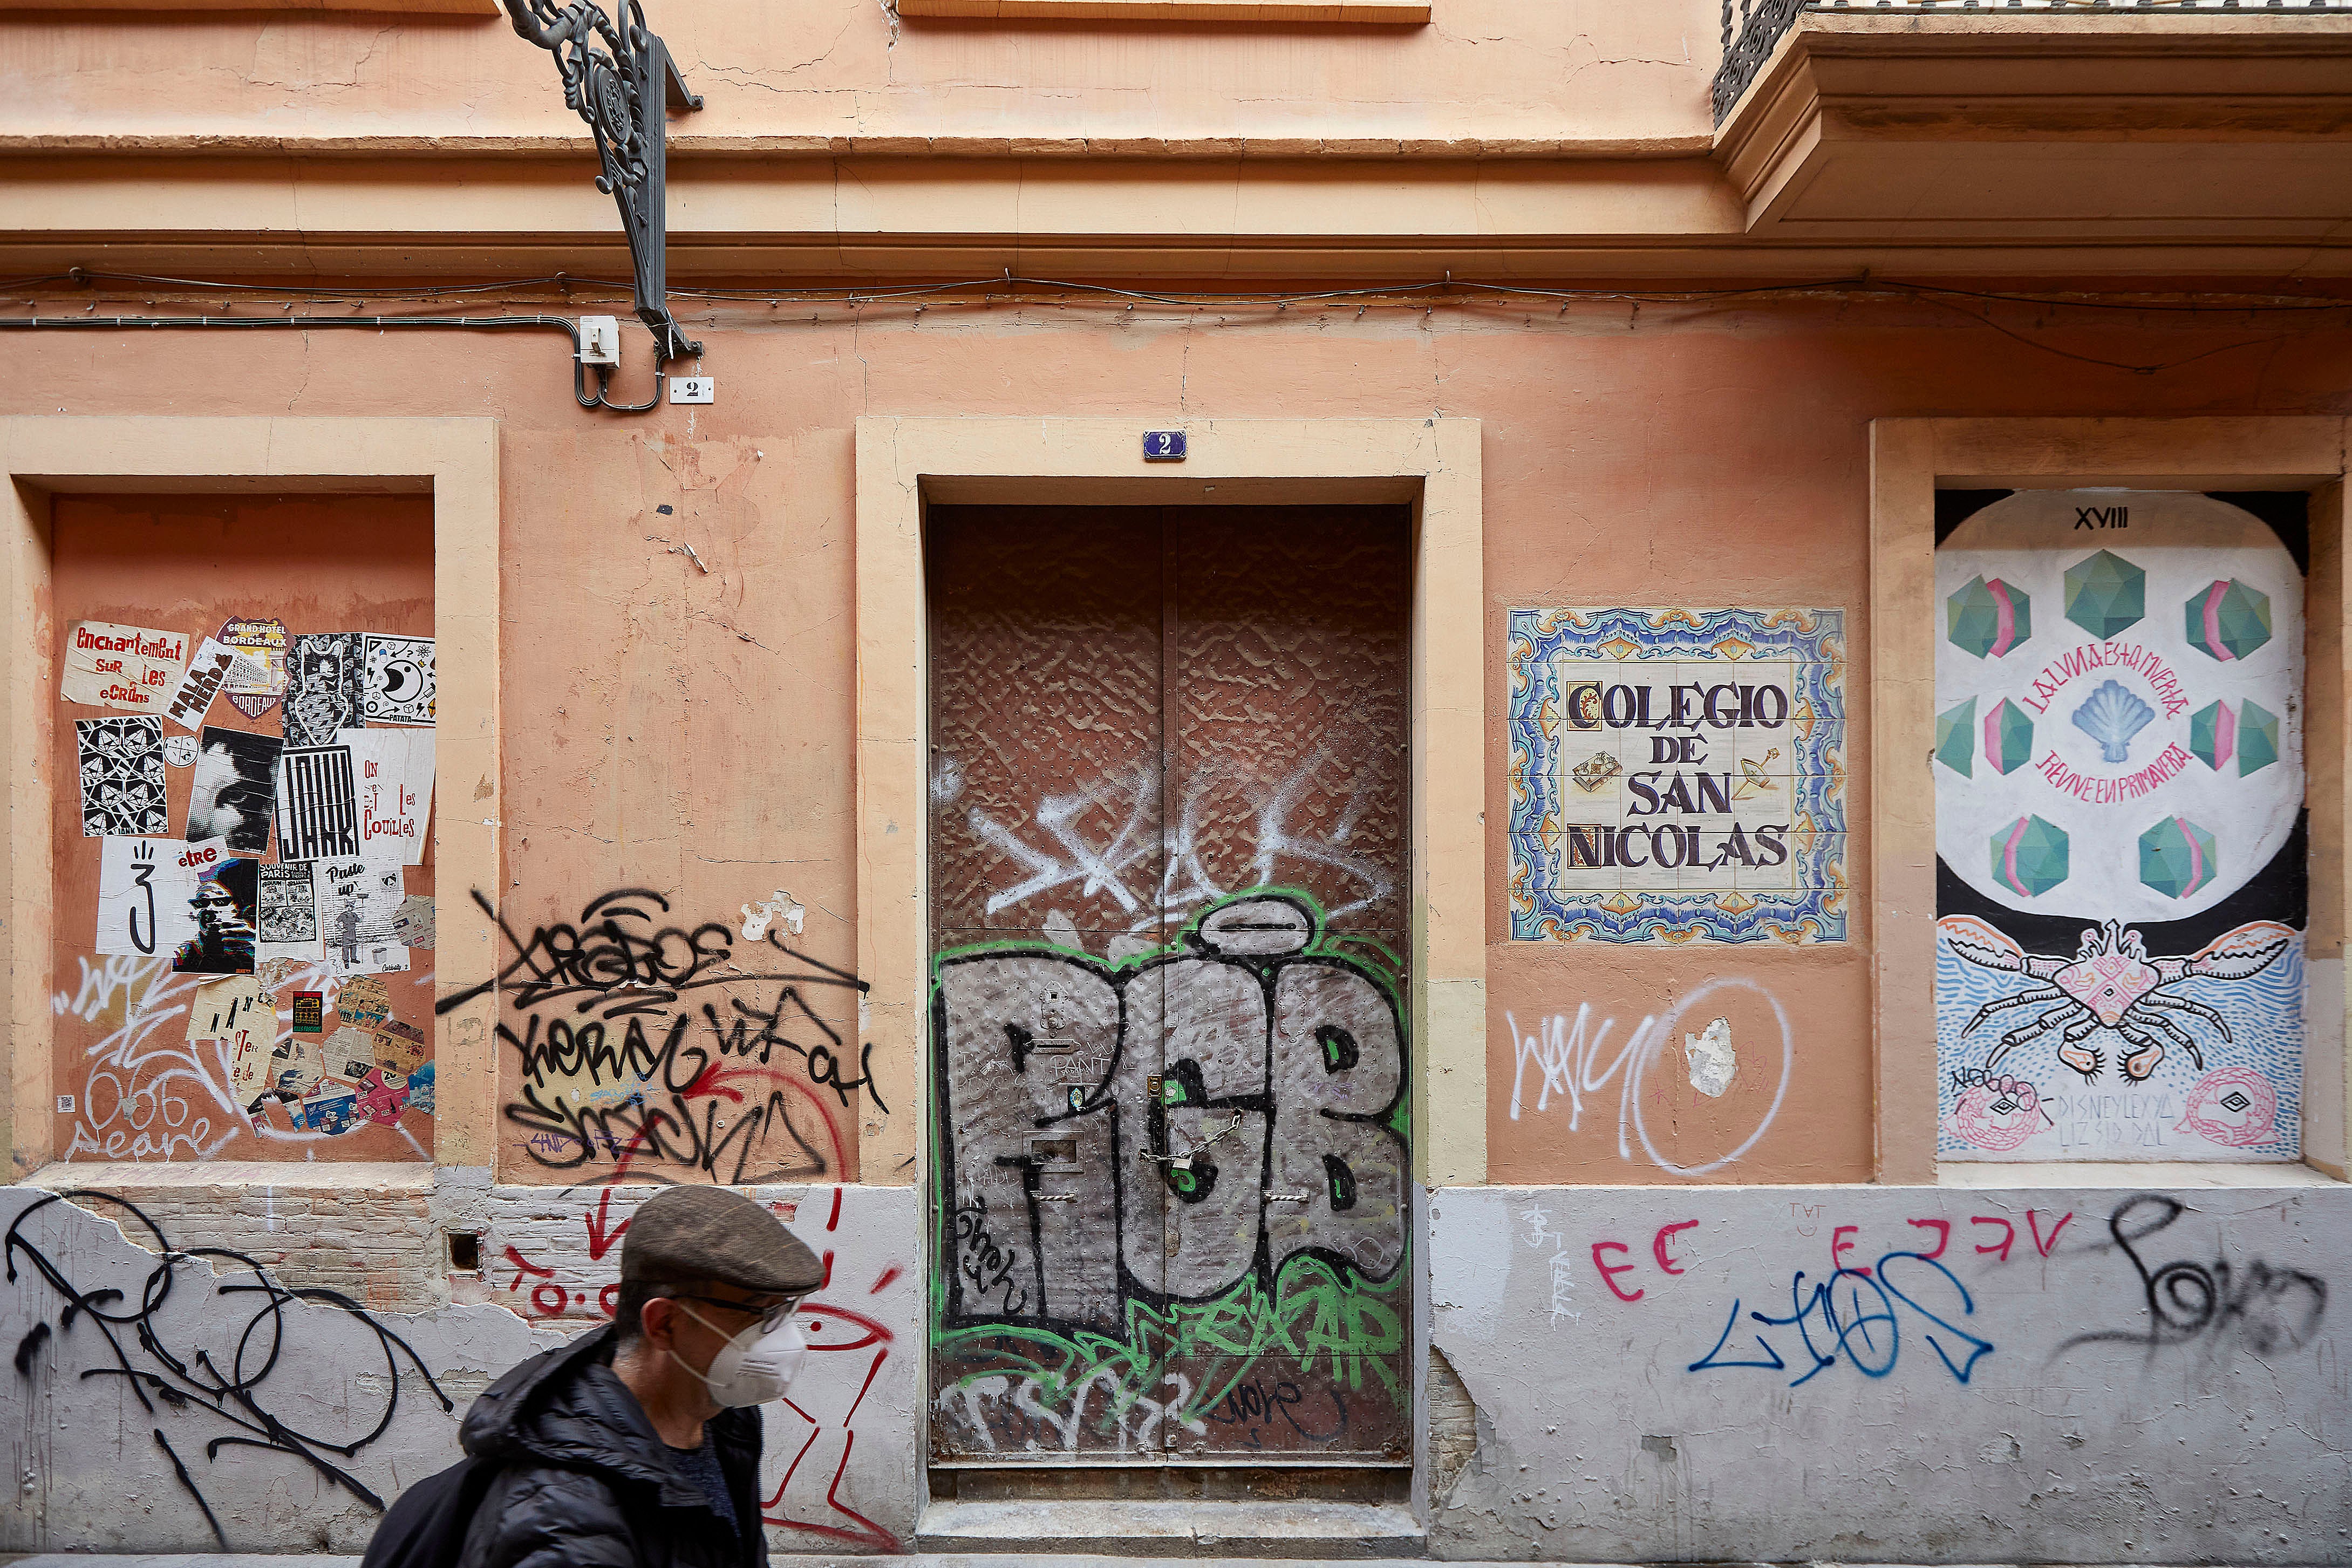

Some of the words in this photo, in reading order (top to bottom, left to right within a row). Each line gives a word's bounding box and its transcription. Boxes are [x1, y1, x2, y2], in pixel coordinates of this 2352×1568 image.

[686, 381, 699, 397] 2
[1158, 433, 1171, 454] 2
[2074, 506, 2128, 530] XVIII
[223, 636, 287, 647] BORDEAUX
[168, 669, 207, 720] MALA
[231, 695, 277, 718] BORDEAUX
[1567, 681, 1789, 732] COLEGIO
[388, 714, 412, 723] PATATA
[1648, 733, 1708, 766] DE
[364, 759, 379, 779] ON
[2118, 741, 2193, 802] PRIMAVERA
[1626, 770, 1733, 818] SAN
[1567, 822, 1790, 872] NICOLAS
[259, 863, 298, 871] SOUVENIR
